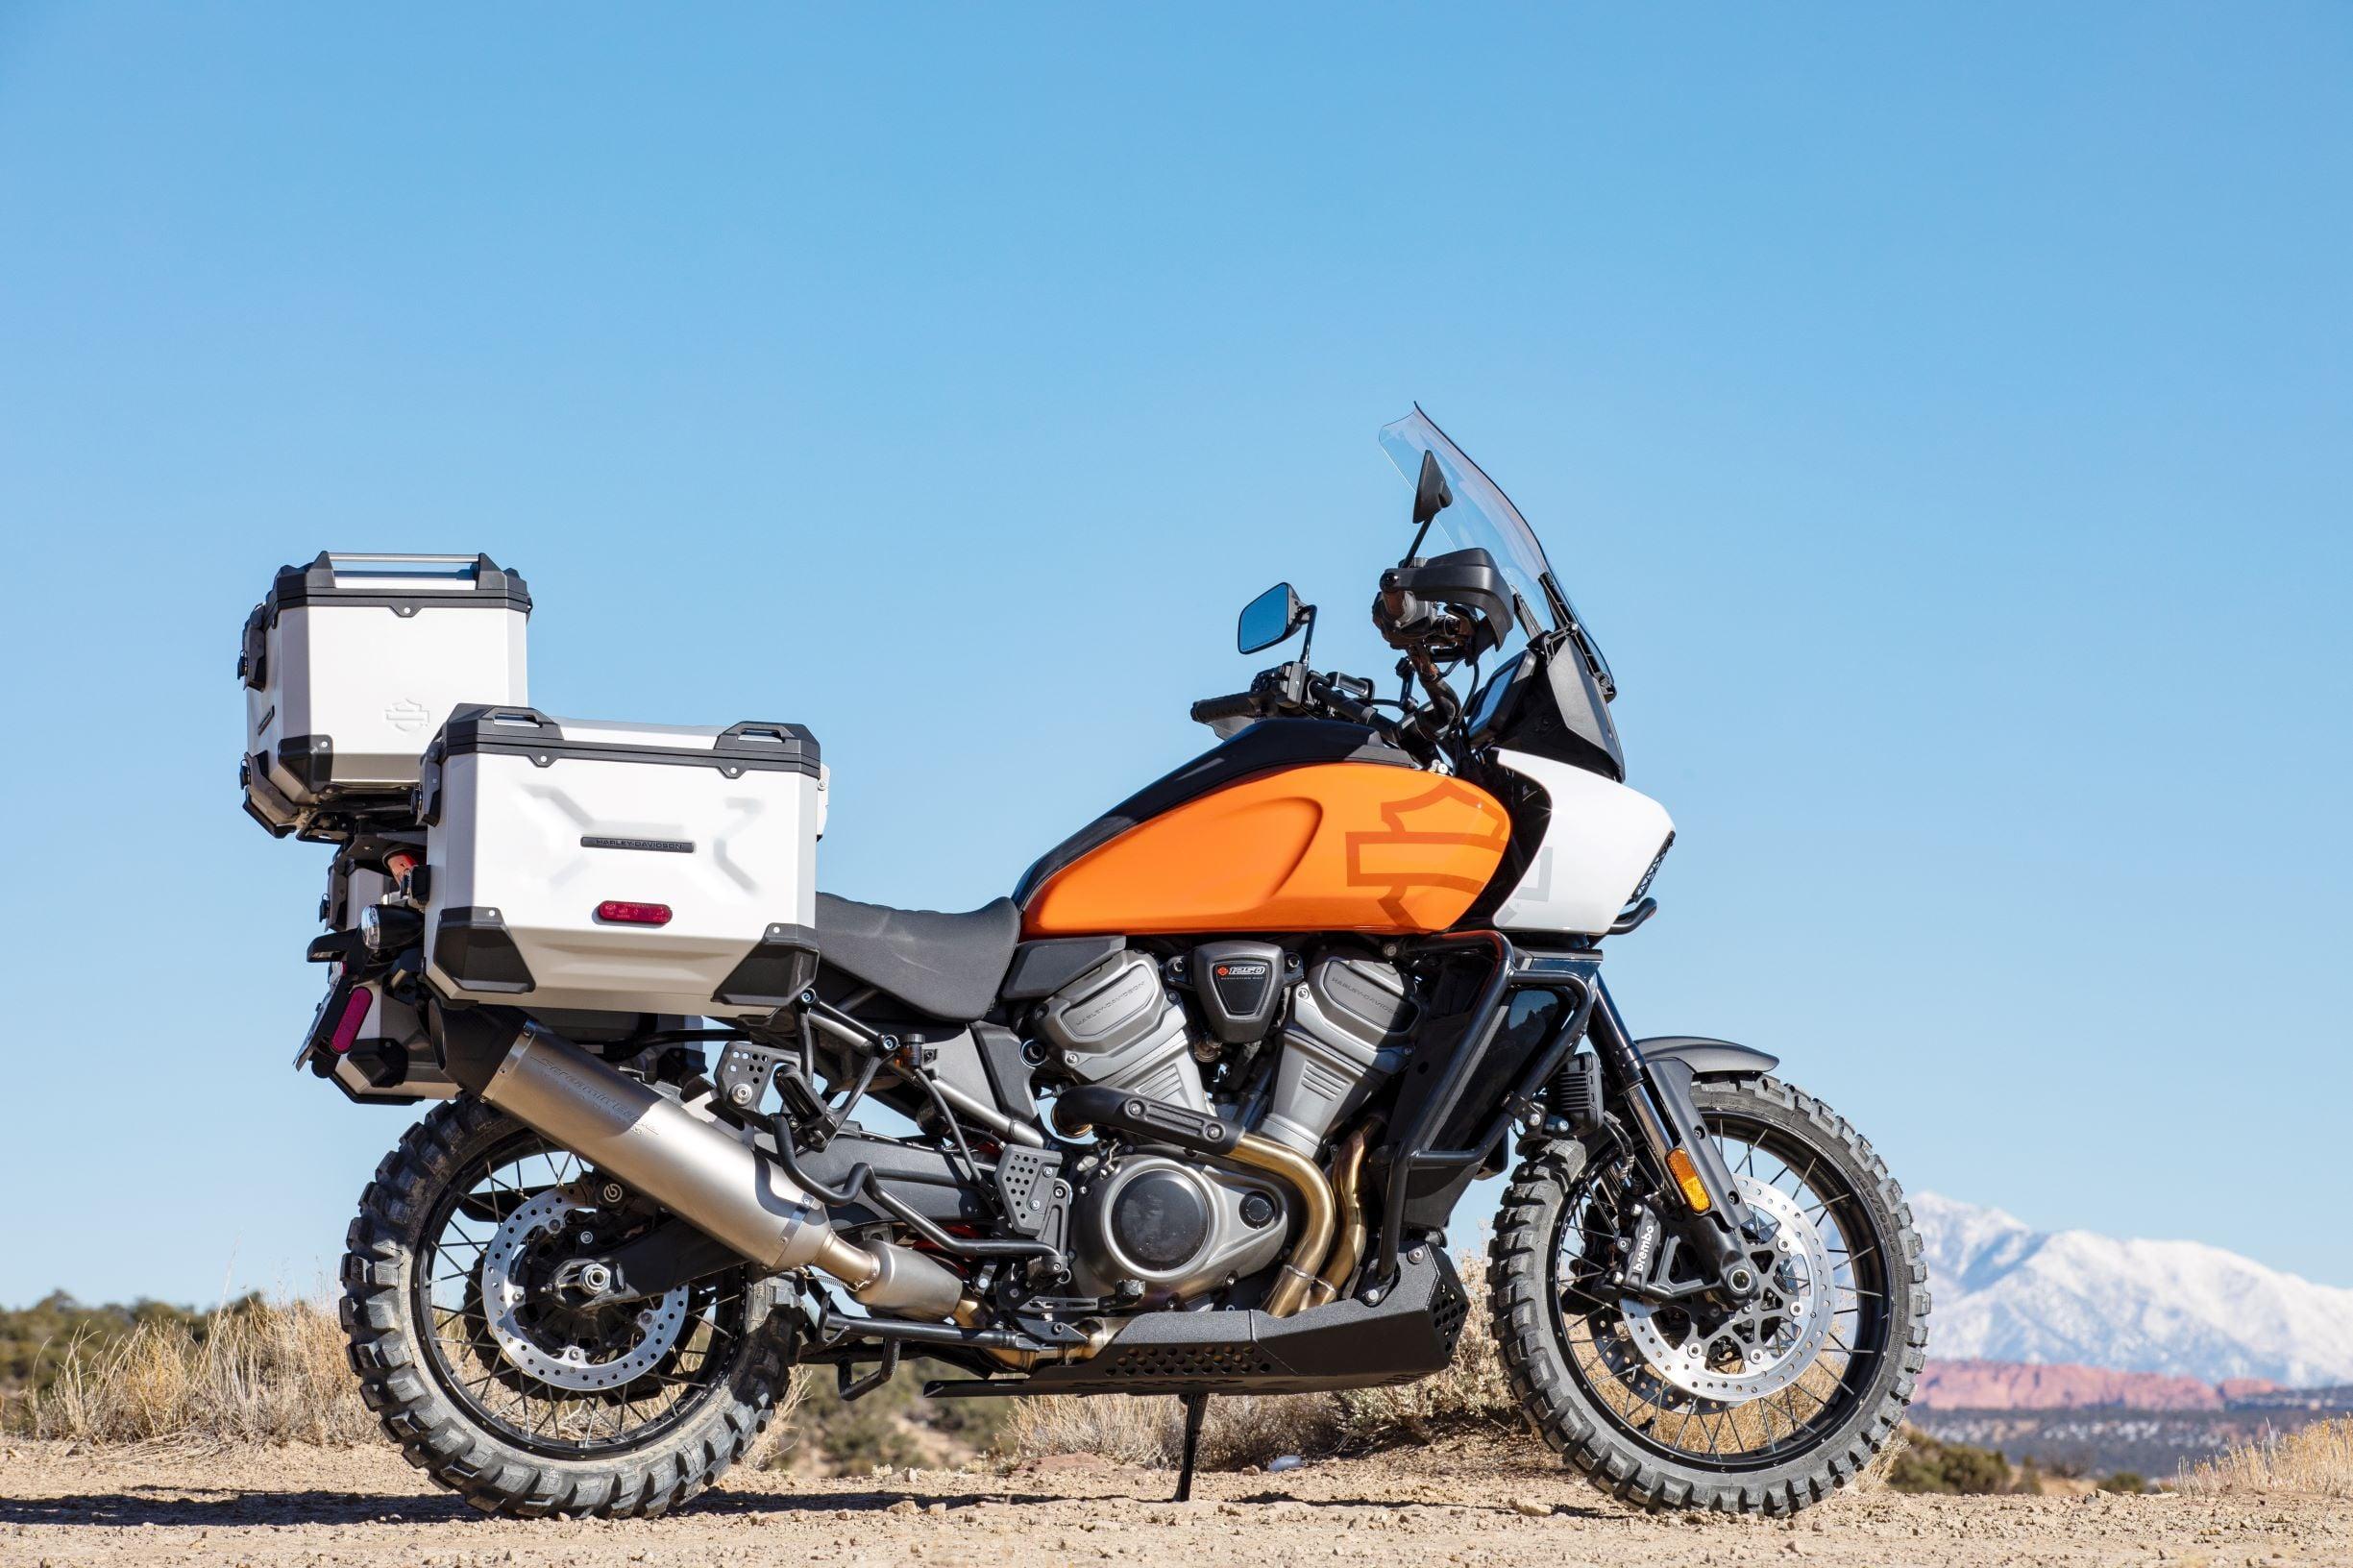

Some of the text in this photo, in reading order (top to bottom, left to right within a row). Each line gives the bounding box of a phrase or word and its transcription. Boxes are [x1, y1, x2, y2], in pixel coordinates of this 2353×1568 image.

[596, 838, 683, 851] HARLEY-DAVIDSON
[1229, 965, 1266, 975] 1250
[1331, 975, 1399, 1016] HARLEY-DAVIDS
[1632, 1224, 1654, 1272] brembo
